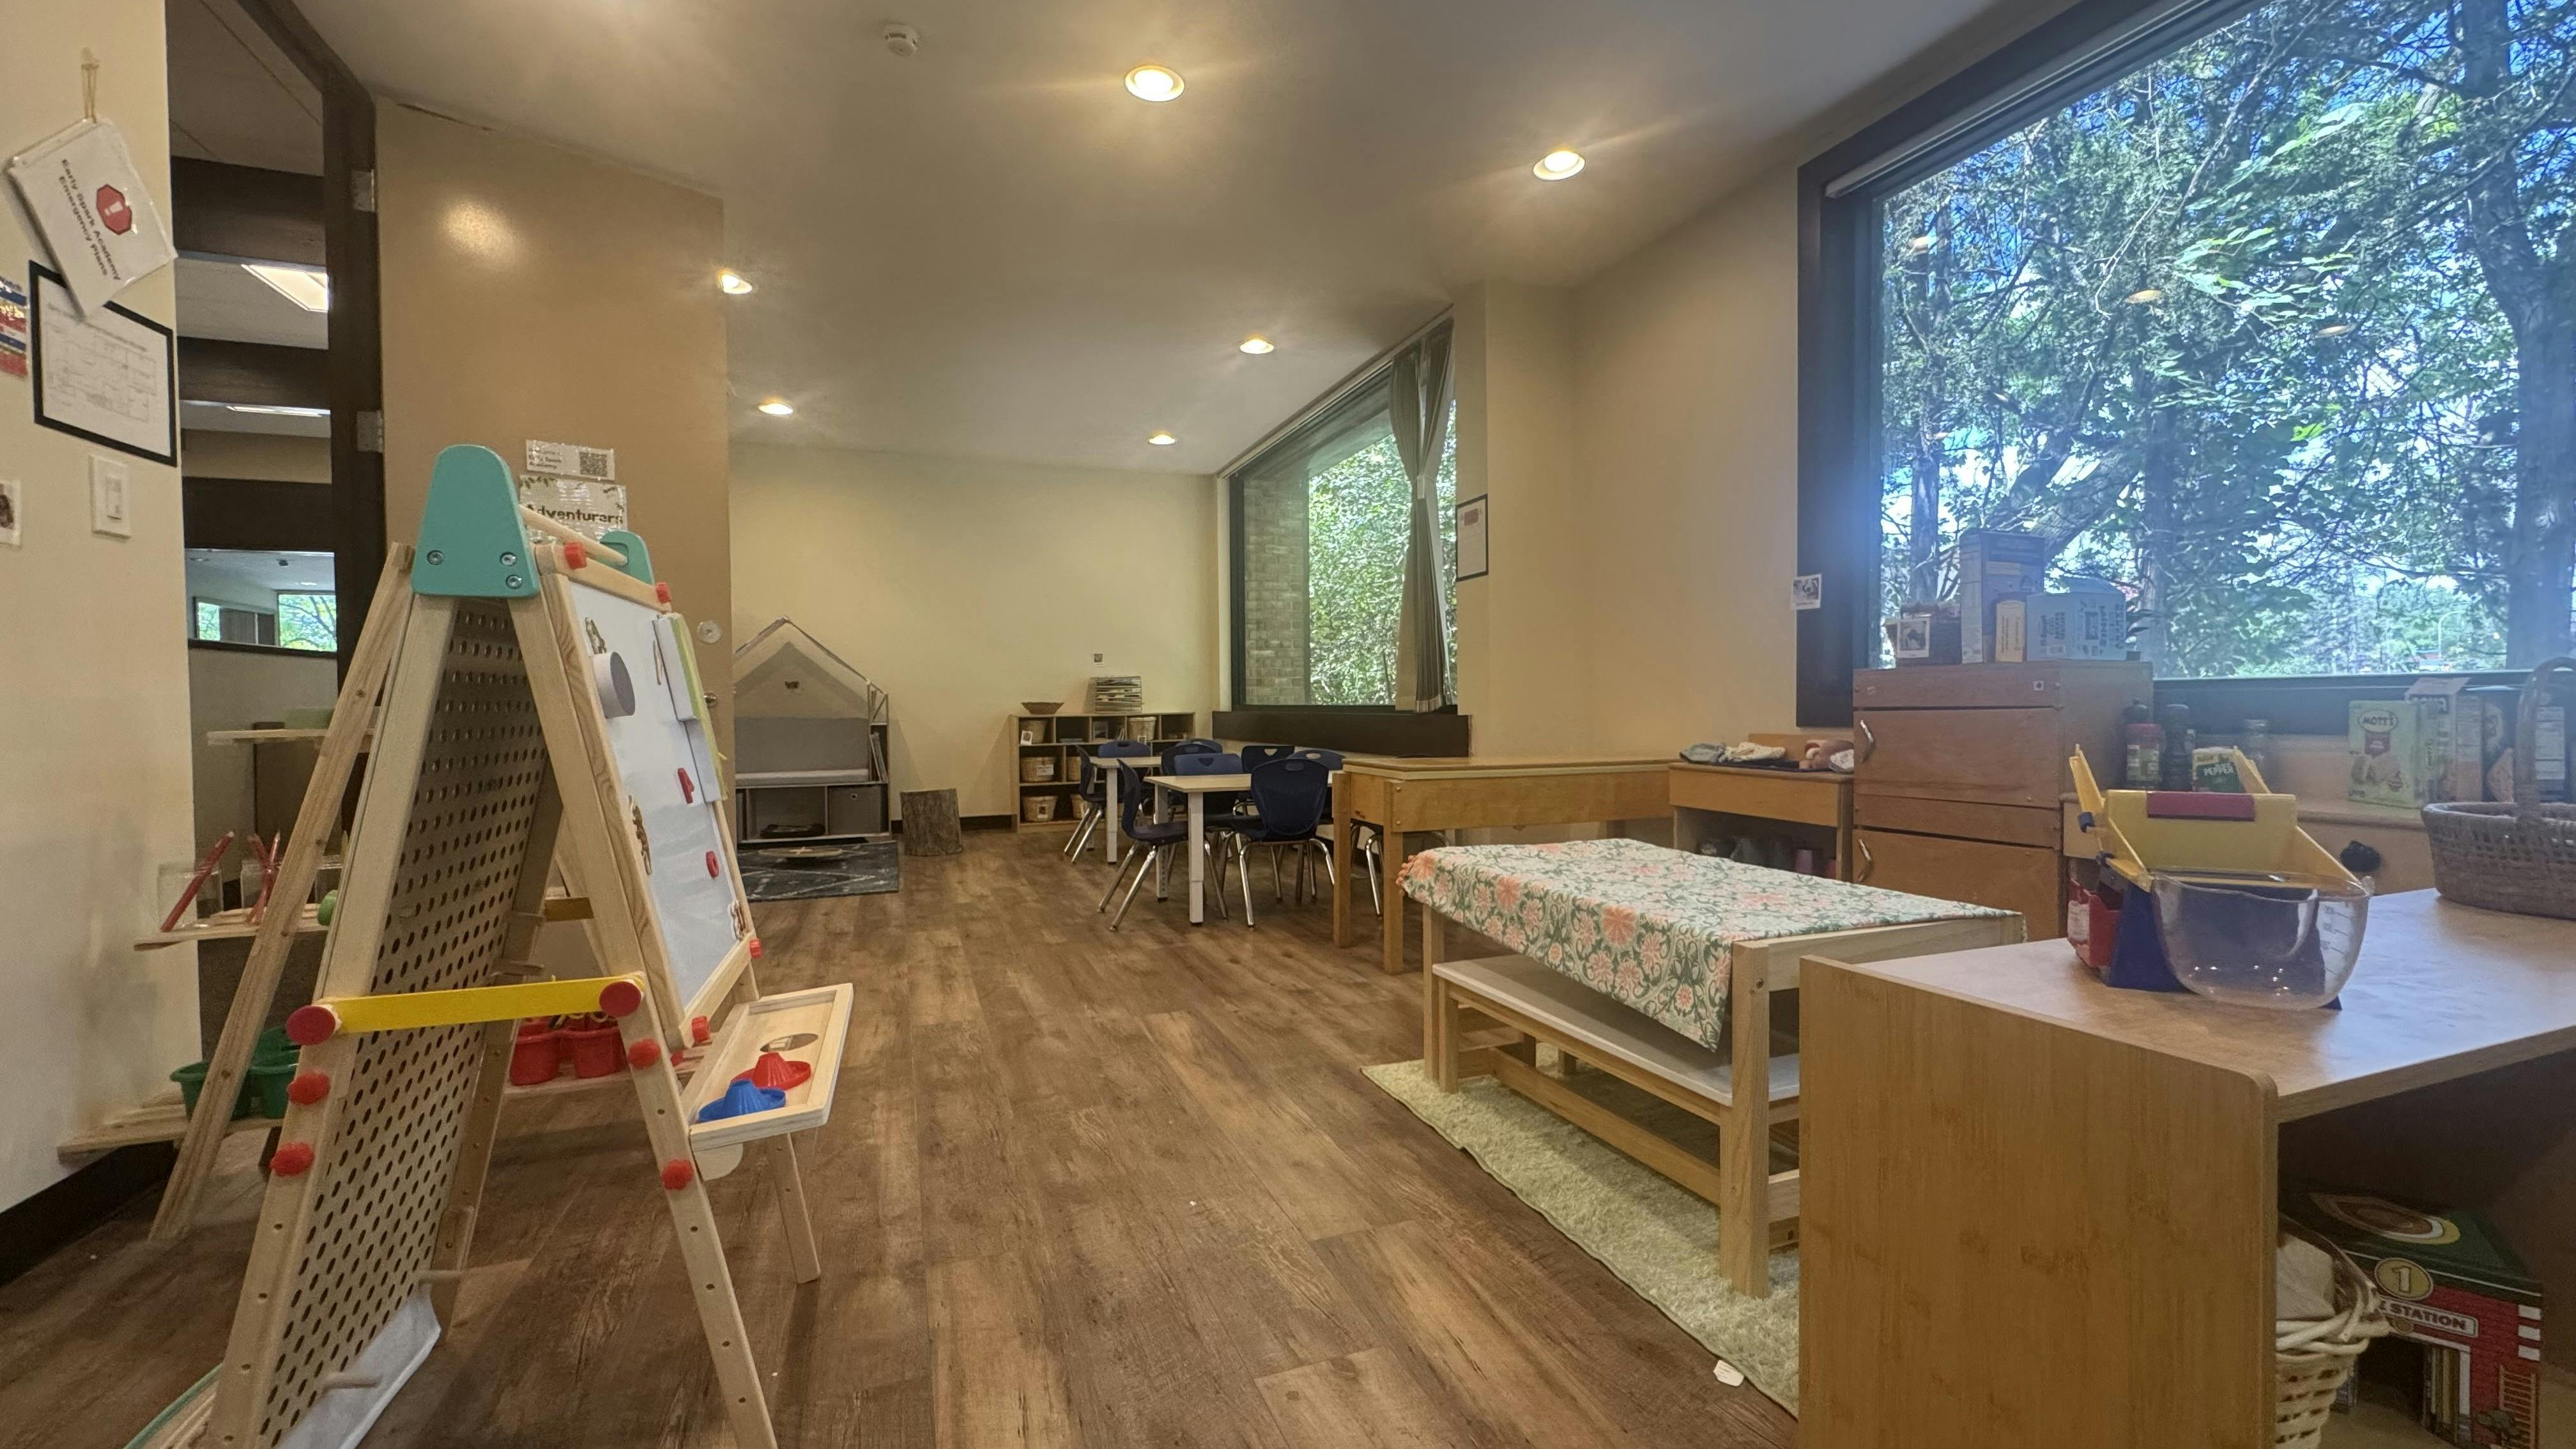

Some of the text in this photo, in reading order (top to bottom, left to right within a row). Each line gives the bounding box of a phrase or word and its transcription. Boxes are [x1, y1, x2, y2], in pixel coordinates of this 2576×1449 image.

[59, 176, 107, 276] Emergency Plans
[61, 158, 121, 280] Early Spark Academy
[2362, 716, 2395, 726] MOTT'S
[2204, 767, 2234, 776] PEPPER
[2391, 1266, 2412, 1294] 1
[2390, 1303, 2466, 1331] STATION
